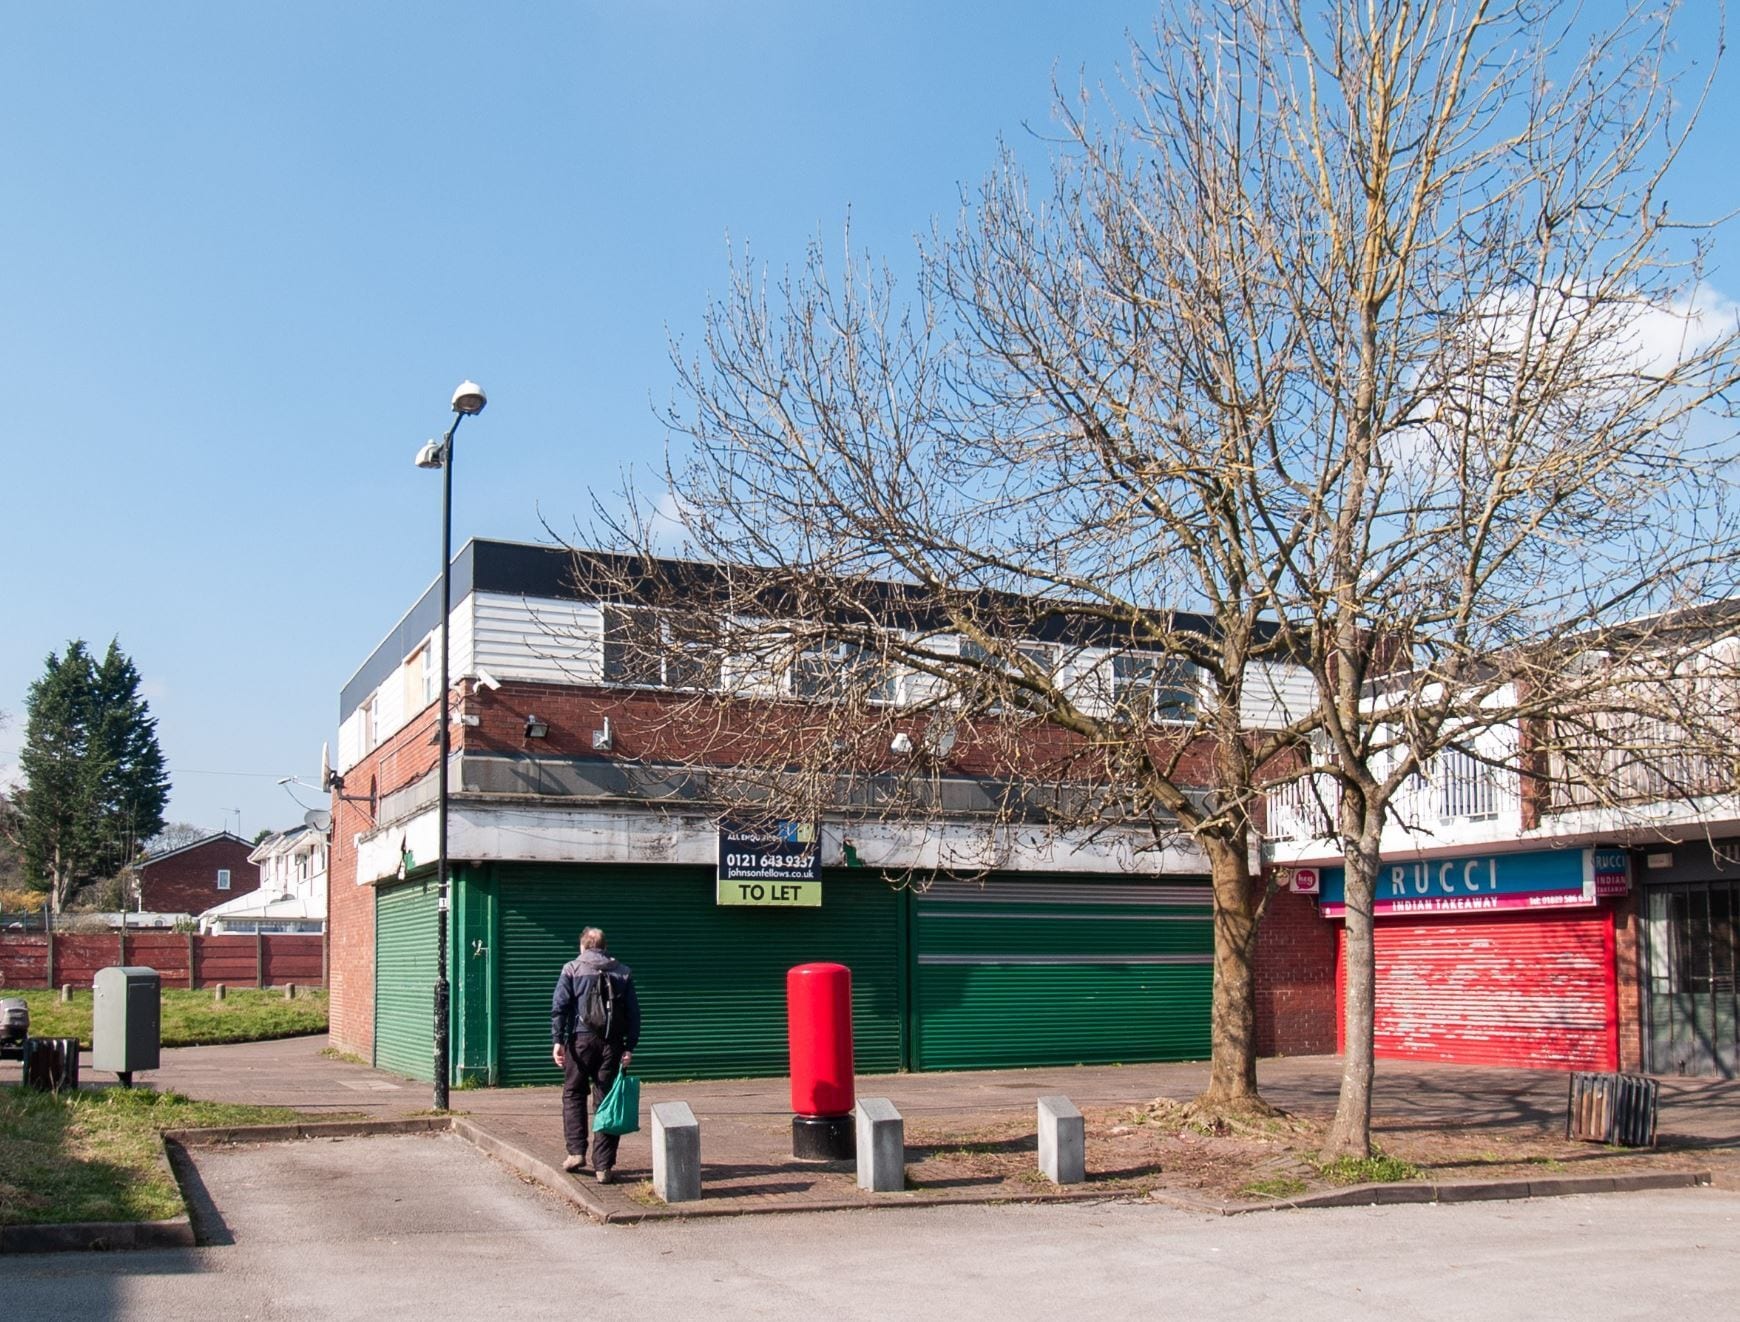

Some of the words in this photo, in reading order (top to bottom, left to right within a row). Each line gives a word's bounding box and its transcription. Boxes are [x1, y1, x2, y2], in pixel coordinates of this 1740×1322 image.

[727, 854, 756, 867] 0121
[760, 855, 783, 867] 643
[1595, 855, 1625, 868] RUCCI
[728, 868, 815, 879] johnsonfellows.co.uk
[1392, 859, 1497, 895] RUCCI
[1597, 876, 1626, 885] INDIAN
[739, 885, 765, 900] TO
[772, 885, 802, 901] LET
[1392, 899, 1433, 911] INDIAN
[1435, 896, 1498, 910] TAKEAWAY
